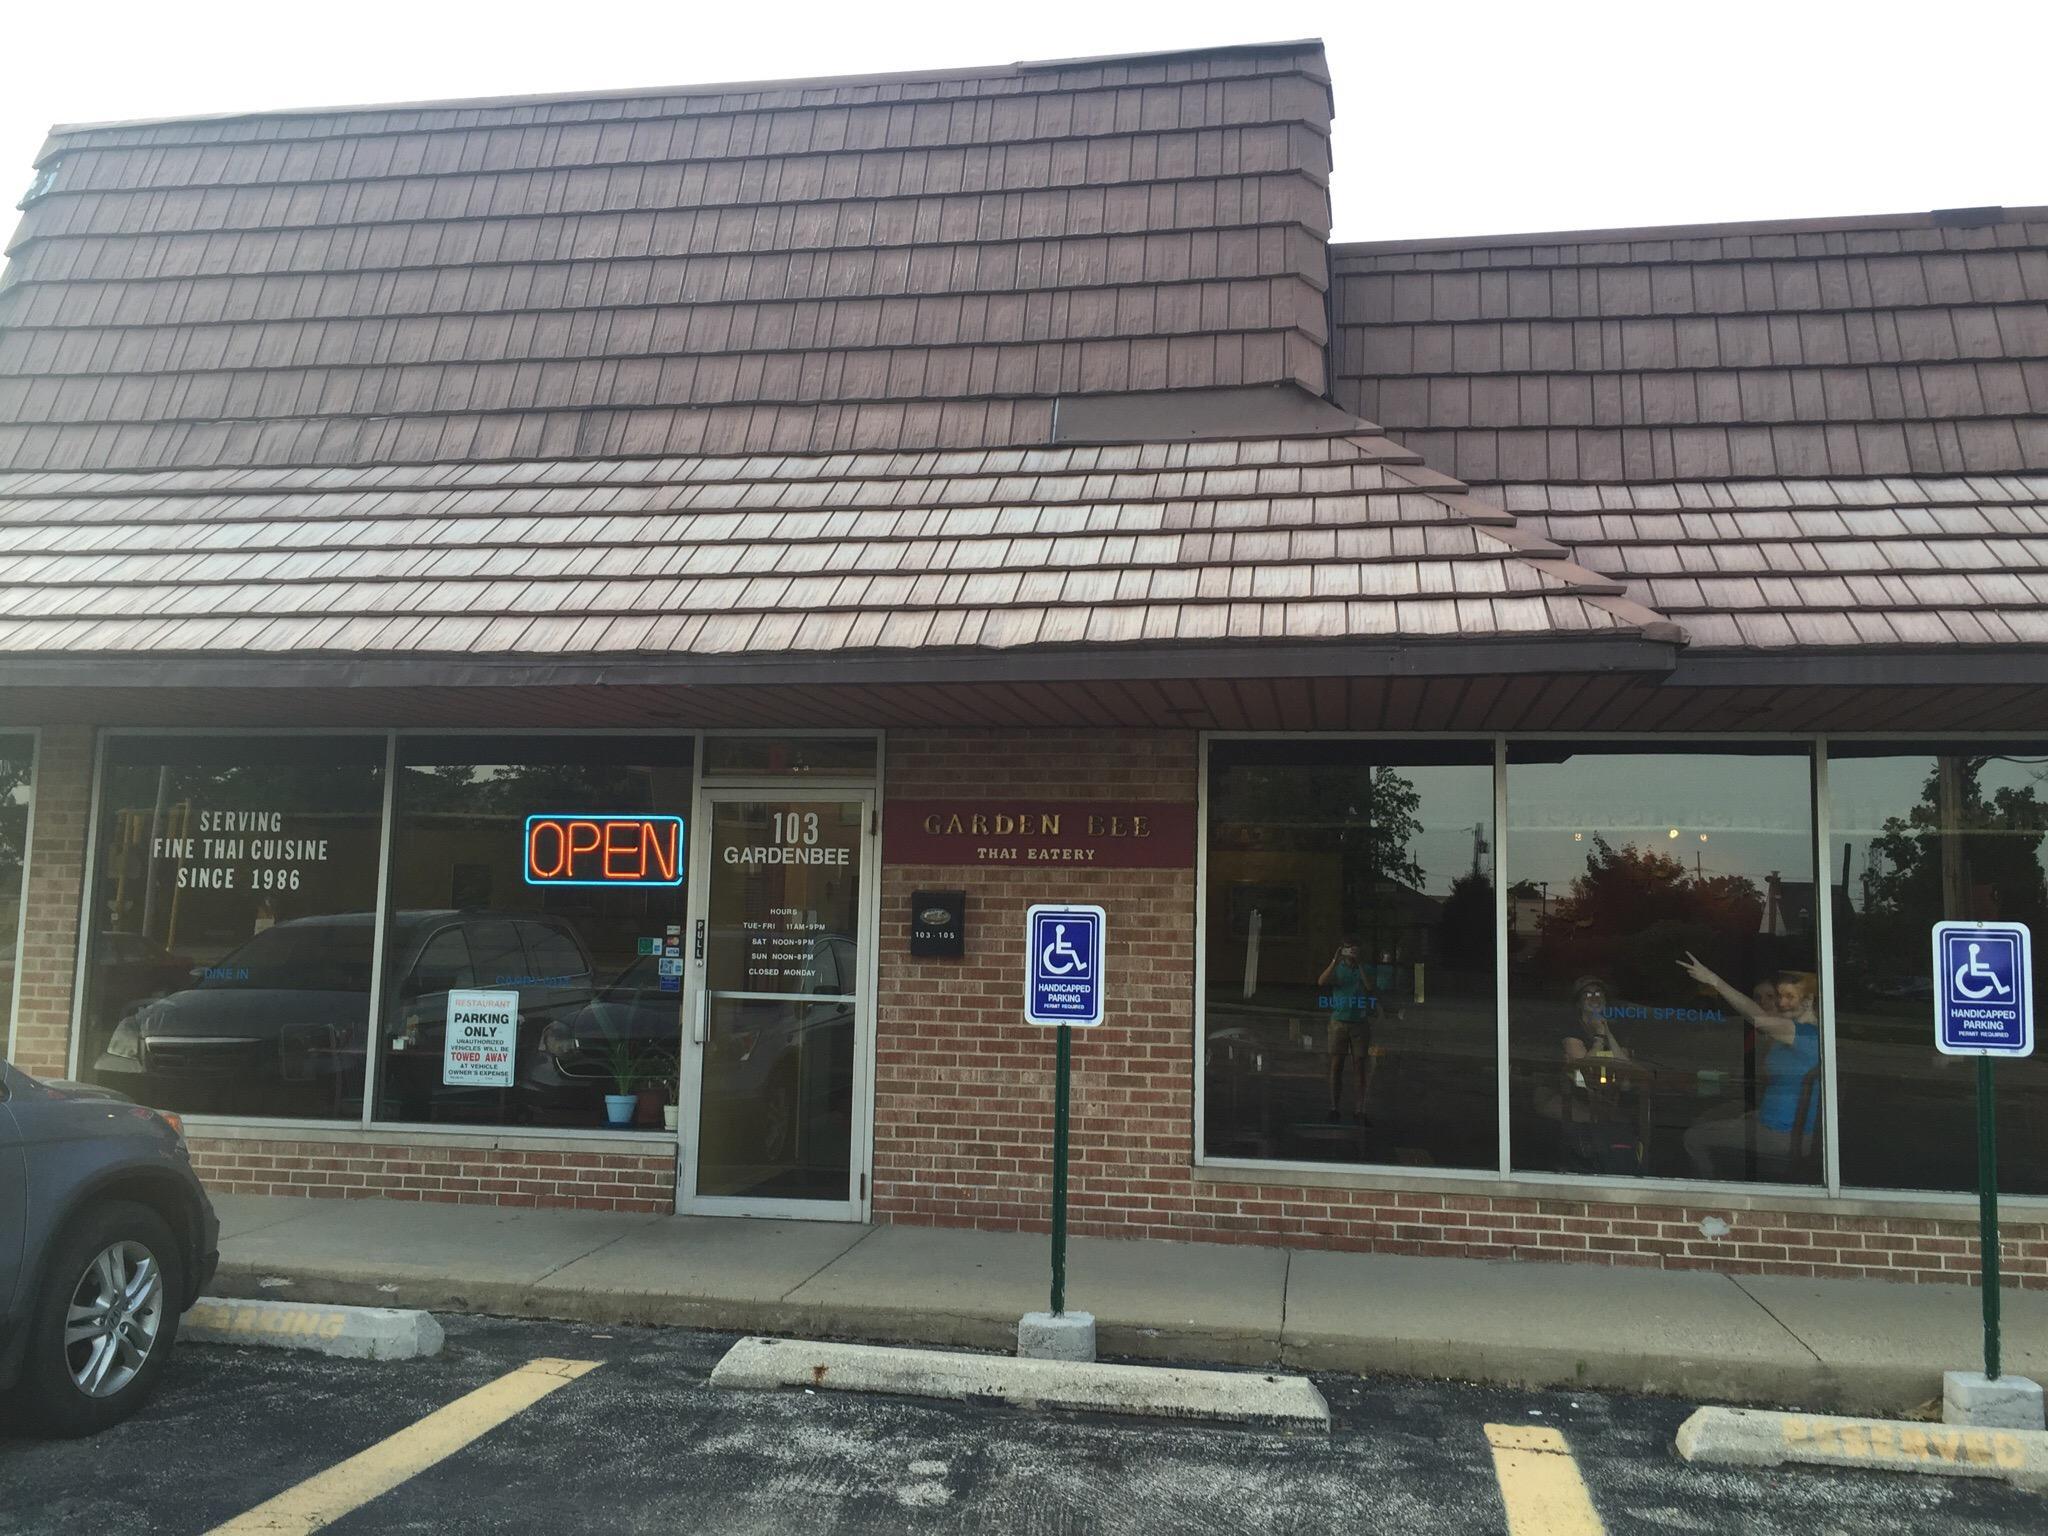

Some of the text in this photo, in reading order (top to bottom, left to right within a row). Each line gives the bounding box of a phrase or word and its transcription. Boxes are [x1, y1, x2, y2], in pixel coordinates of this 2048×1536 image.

[200, 811, 282, 832] SERVING
[924, 813, 1060, 836] GARDEN
[773, 812, 819, 845] 103
[153, 838, 328, 861] FINE THAI CUISINE
[530, 821, 678, 880] OPEN
[723, 846, 850, 865] GARDENBEE
[977, 848, 1095, 860] THAI EATERY
[177, 867, 300, 890] SINCE 1986
[770, 908, 798, 916] HOURS
[696, 921, 704, 958] PULL
[748, 968, 816, 977] CLOSED MONDAY
[1038, 983, 1091, 993] HANDICAPPED
[455, 1000, 511, 1008] RESTAURANT
[1048, 994, 1081, 1003] PARKING
[1318, 995, 1378, 1010] BUFFET
[454, 1013, 510, 1024] PARKING
[1654, 1007, 1728, 1023] SPECIAL
[1951, 1008, 2016, 1019] HANDICAPPED
[1963, 1020, 2004, 1030] PARKING
[464, 1026, 497, 1037] ONLY
[451, 1052, 508, 1063] TOWED AWAY
